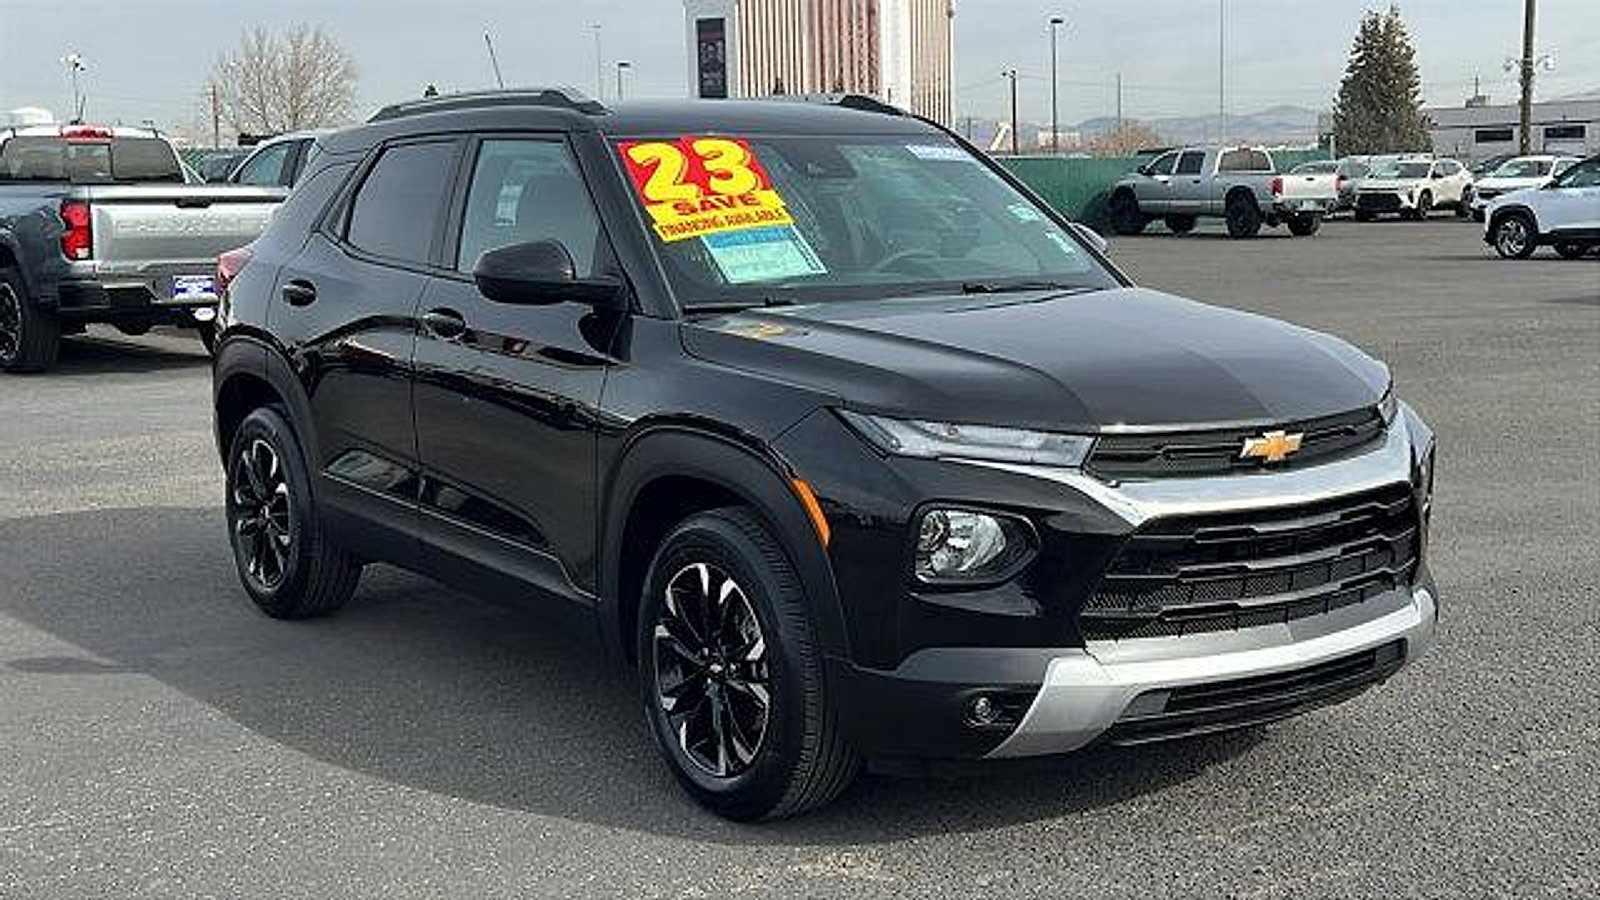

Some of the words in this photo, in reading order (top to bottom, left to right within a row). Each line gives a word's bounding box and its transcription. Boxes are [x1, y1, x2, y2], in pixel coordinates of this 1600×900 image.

[627, 138, 762, 204] 23
[672, 194, 762, 216] SAVE
[660, 216, 725, 237] FINANCING
[725, 209, 783, 226] AVAILABLE
